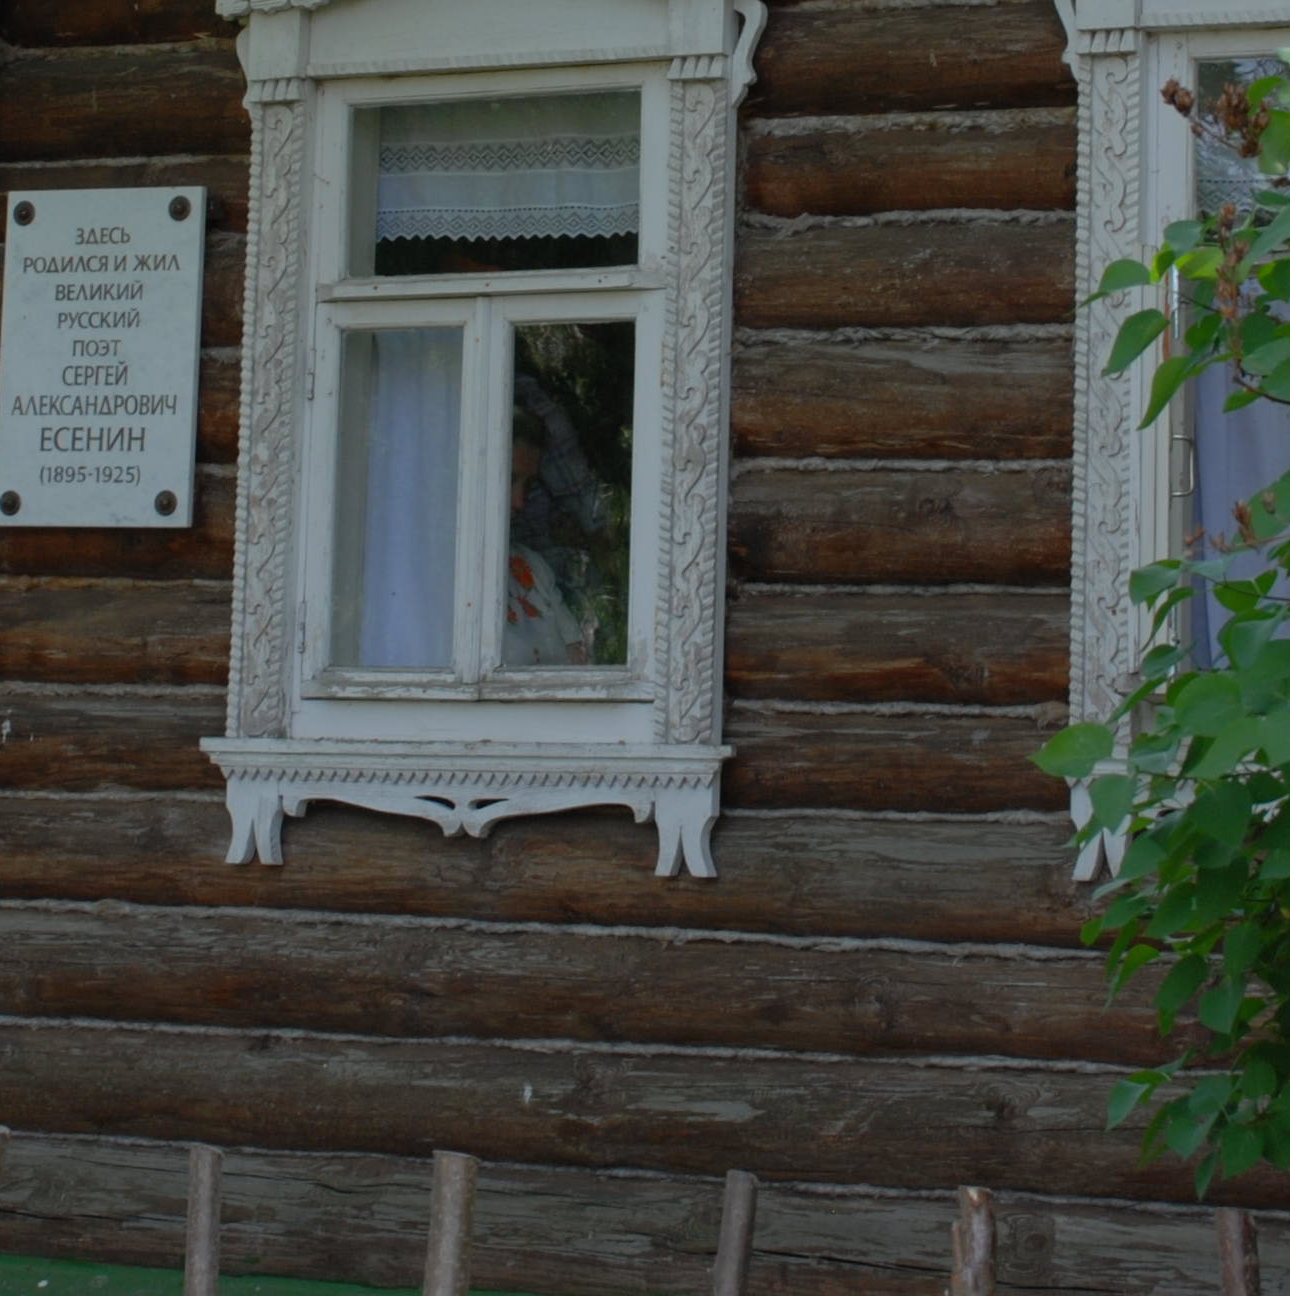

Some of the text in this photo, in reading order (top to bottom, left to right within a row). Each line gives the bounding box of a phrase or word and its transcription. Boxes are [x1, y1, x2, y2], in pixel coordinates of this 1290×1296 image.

[74, 226, 131, 245] ЗДЕСЬ
[22, 254, 180, 274] РОДИЛСЯ И ЖИЛ
[54, 280, 144, 301] ВЕЛИКИЙ
[57, 307, 141, 329] РУССКИЙ
[72, 339, 121, 357] ПОЭТ
[61, 361, 129, 386] СЕРГЕЙ
[11, 394, 177, 417] АЛЕКСАНДРОВИЧ
[39, 427, 146, 452] ЕСЕНИН
[39, 465, 141, 486] (1895-1925)
